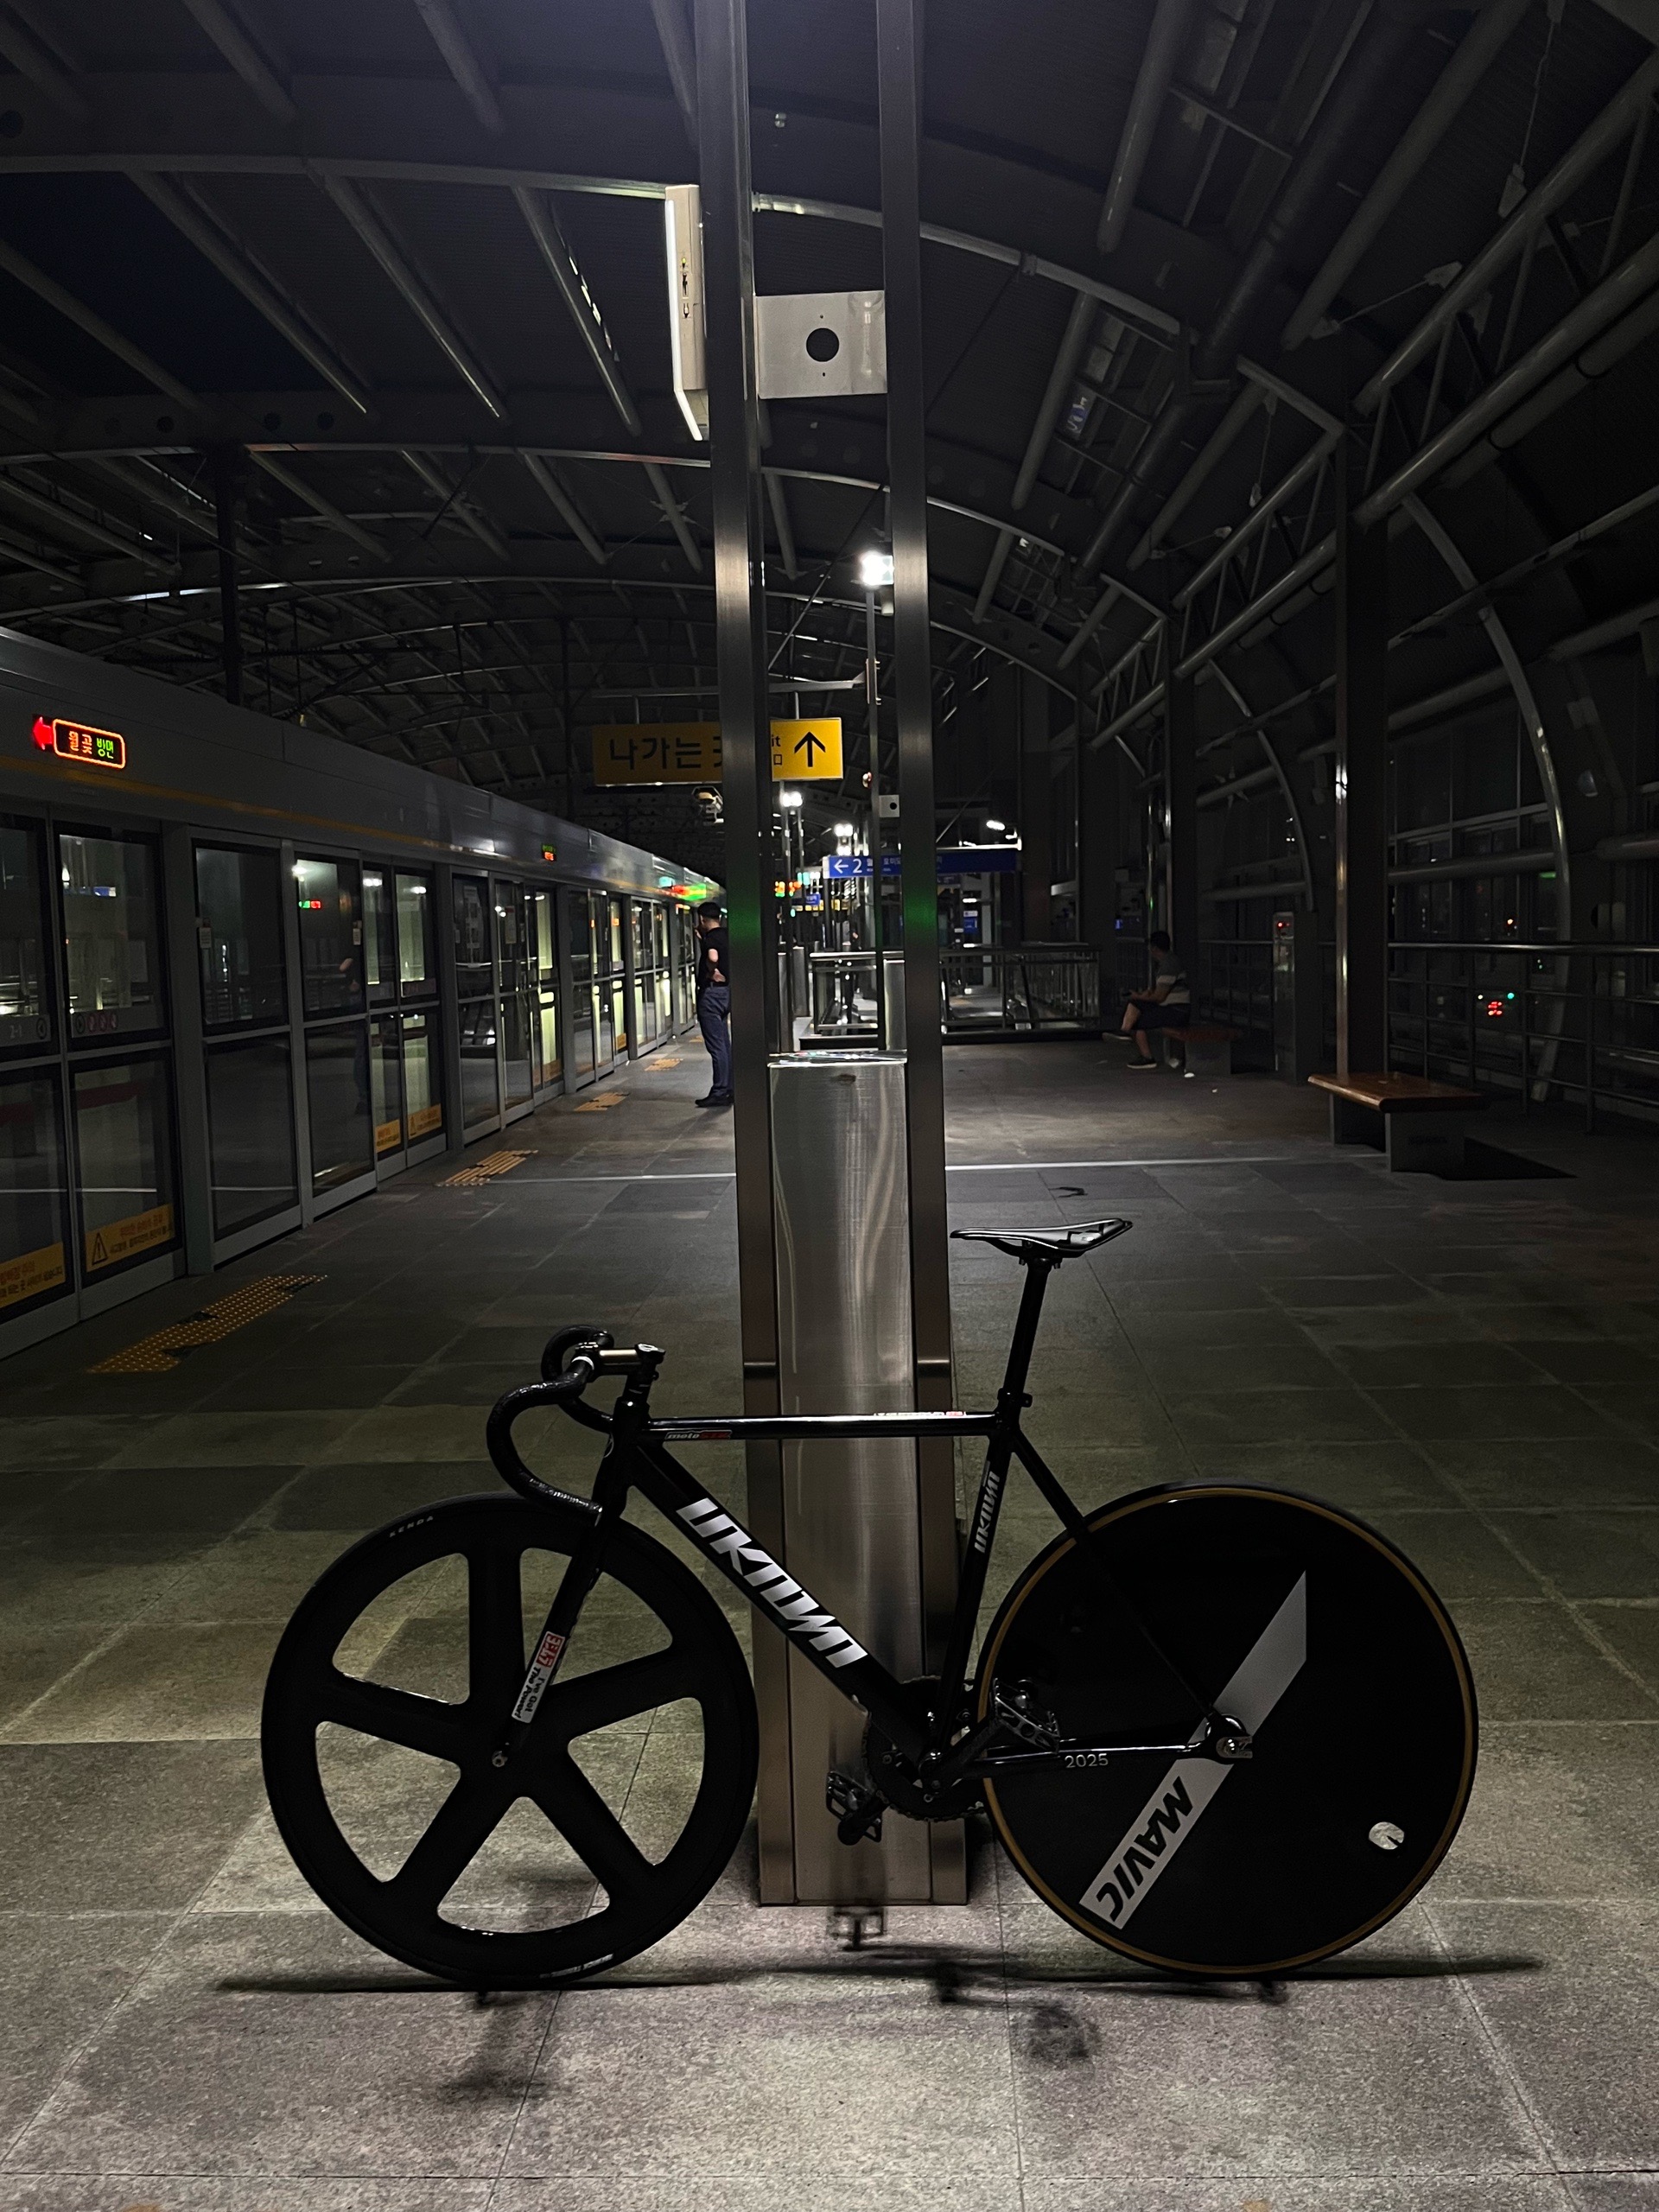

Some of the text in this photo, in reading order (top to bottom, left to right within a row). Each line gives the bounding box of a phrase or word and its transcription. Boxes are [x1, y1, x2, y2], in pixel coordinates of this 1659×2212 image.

[96, 737, 114, 760] 방면
[772, 734, 781, 747] it
[609, 737, 702, 770] 나가는
[852, 858, 863, 874] 2
[528, 1667, 542, 1684] The
[524, 1696, 537, 1713] Got
[1065, 1753, 1109, 1769] 2025
[1096, 1776, 1193, 1923] MAVIC
